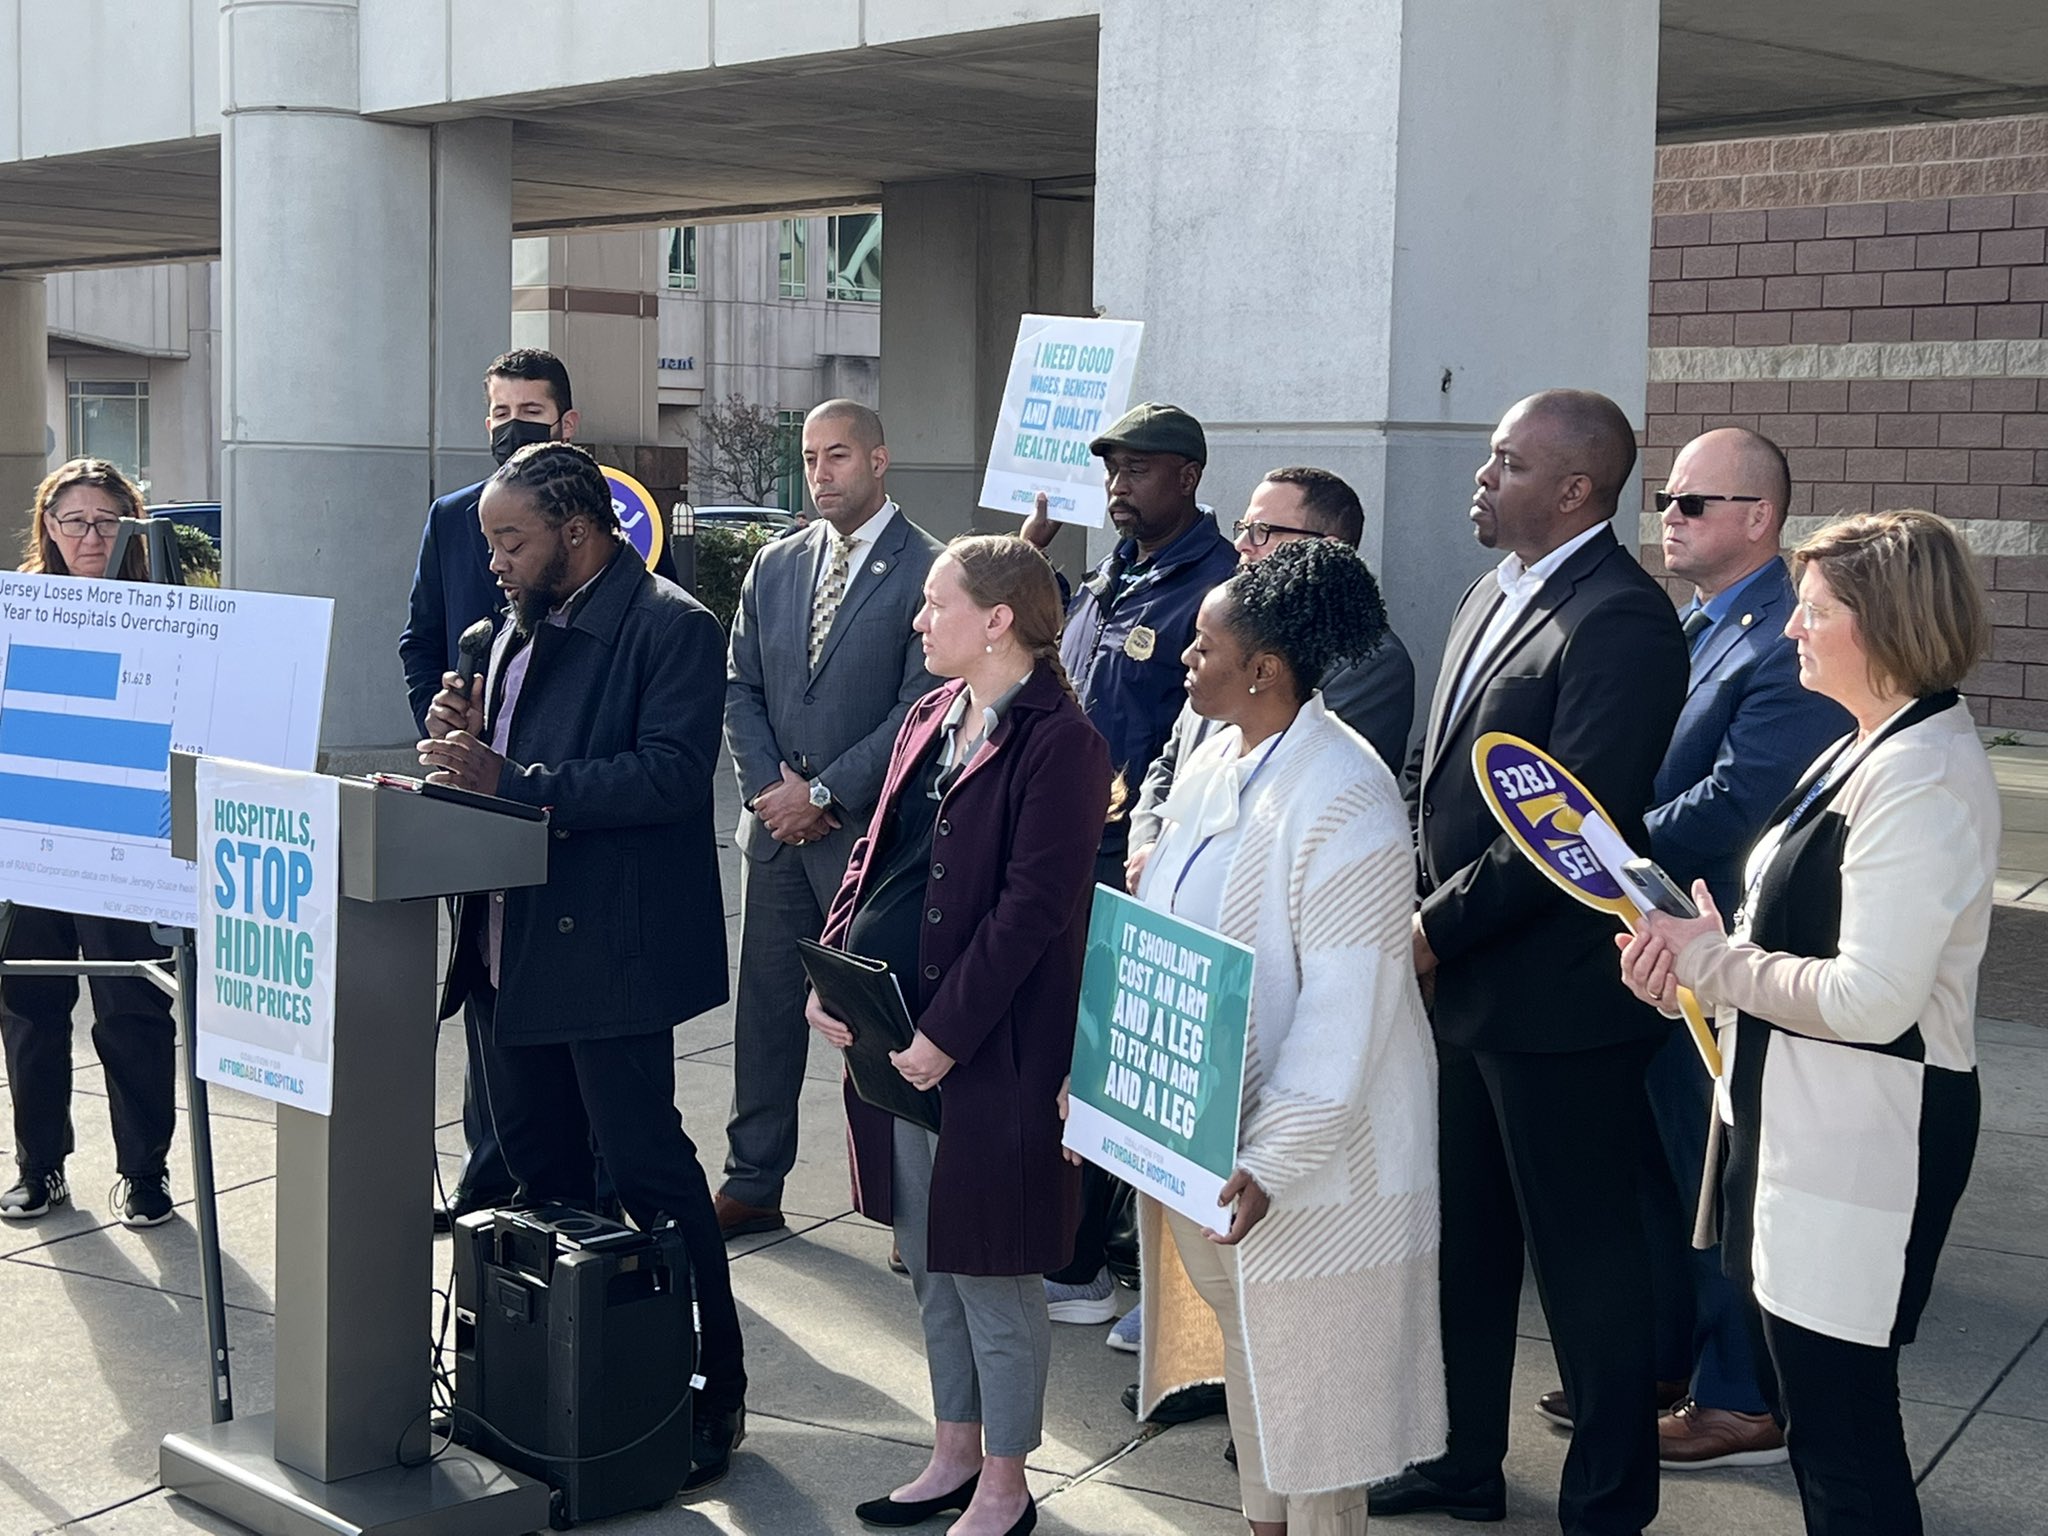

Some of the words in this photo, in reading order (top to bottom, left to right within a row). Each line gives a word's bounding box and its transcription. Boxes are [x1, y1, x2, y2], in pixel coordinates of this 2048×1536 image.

[1033, 342, 1042, 368] I
[1041, 343, 1076, 370] NEED
[1077, 346, 1114, 374] GOOD
[1030, 375, 1060, 396] WAGES,
[1062, 378, 1107, 400] BENEFITS
[1022, 402, 1048, 426] AND
[1053, 405, 1102, 432] QUALITY
[1014, 433, 1060, 462] HEALTH
[1061, 440, 1091, 466] CARE
[0, 579, 40, 602] Jersey
[44, 582, 82, 600] Loses
[87, 586, 122, 605] More
[128, 588, 161, 607] Than
[166, 589, 182, 611] $1
[189, 594, 235, 613] Billion
[3, 602, 31, 620] Year
[36, 607, 48, 622] to
[53, 607, 117, 629] Hospitals
[121, 612, 218, 640] Overcharging
[122, 670, 144, 686] $1.62
[145, 673, 152, 686] B
[1493, 760, 1556, 799] 32BJ
[215, 798, 315, 852] HOSPITALS,
[215, 838, 313, 923] STOP
[1557, 844, 1602, 880] SEI
[216, 914, 313, 990] HIDING
[1122, 922, 1137, 953] IT
[1138, 929, 1212, 987] SHOULDN'T
[215, 974, 252, 1012] YOUR
[257, 985, 312, 1026] PRICES
[1119, 955, 1154, 995] COST
[1153, 971, 1176, 1007] AN
[1176, 982, 1208, 1022] ARM
[1112, 988, 1149, 1037] AND
[1151, 1006, 1165, 1047] A
[1168, 1013, 1203, 1064] LEG
[219, 1057, 262, 1083] AFFORDABLE
[264, 1070, 304, 1095] HOSPITALS
[1110, 1028, 1126, 1060] TO
[1127, 1037, 1149, 1072] FIX
[1149, 1049, 1170, 1082] AN
[1170, 1060, 1200, 1099] ARM
[1104, 1060, 1142, 1111] AND
[1143, 1081, 1157, 1122] A
[1160, 1088, 1196, 1140] LEG
[1102, 1137, 1145, 1175] AFFORDABLE
[1146, 1160, 1186, 1197] HOSPITALS
